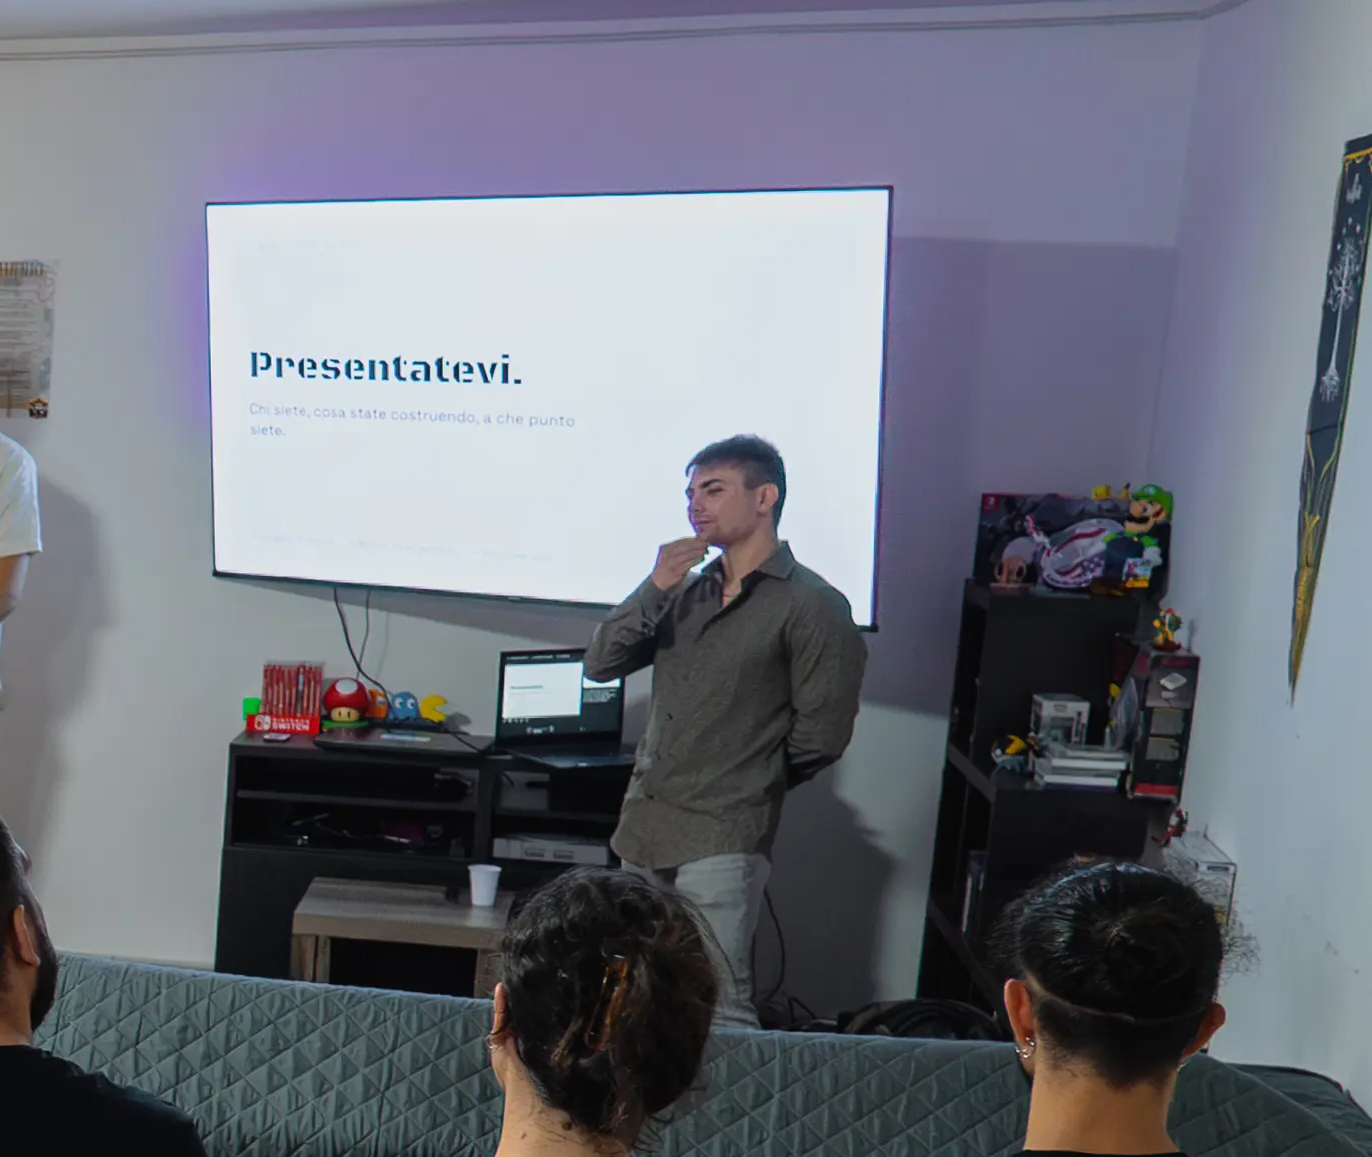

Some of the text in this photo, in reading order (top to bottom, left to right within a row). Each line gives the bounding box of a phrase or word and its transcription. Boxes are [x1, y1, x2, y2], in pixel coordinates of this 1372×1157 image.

[250, 351, 523, 386] Presentatevi.
[249, 402, 576, 428] Chi siete, cosa state costruendo, a che punto
[250, 424, 286, 437] siete.
[272, 721, 310, 731] SWITCH
